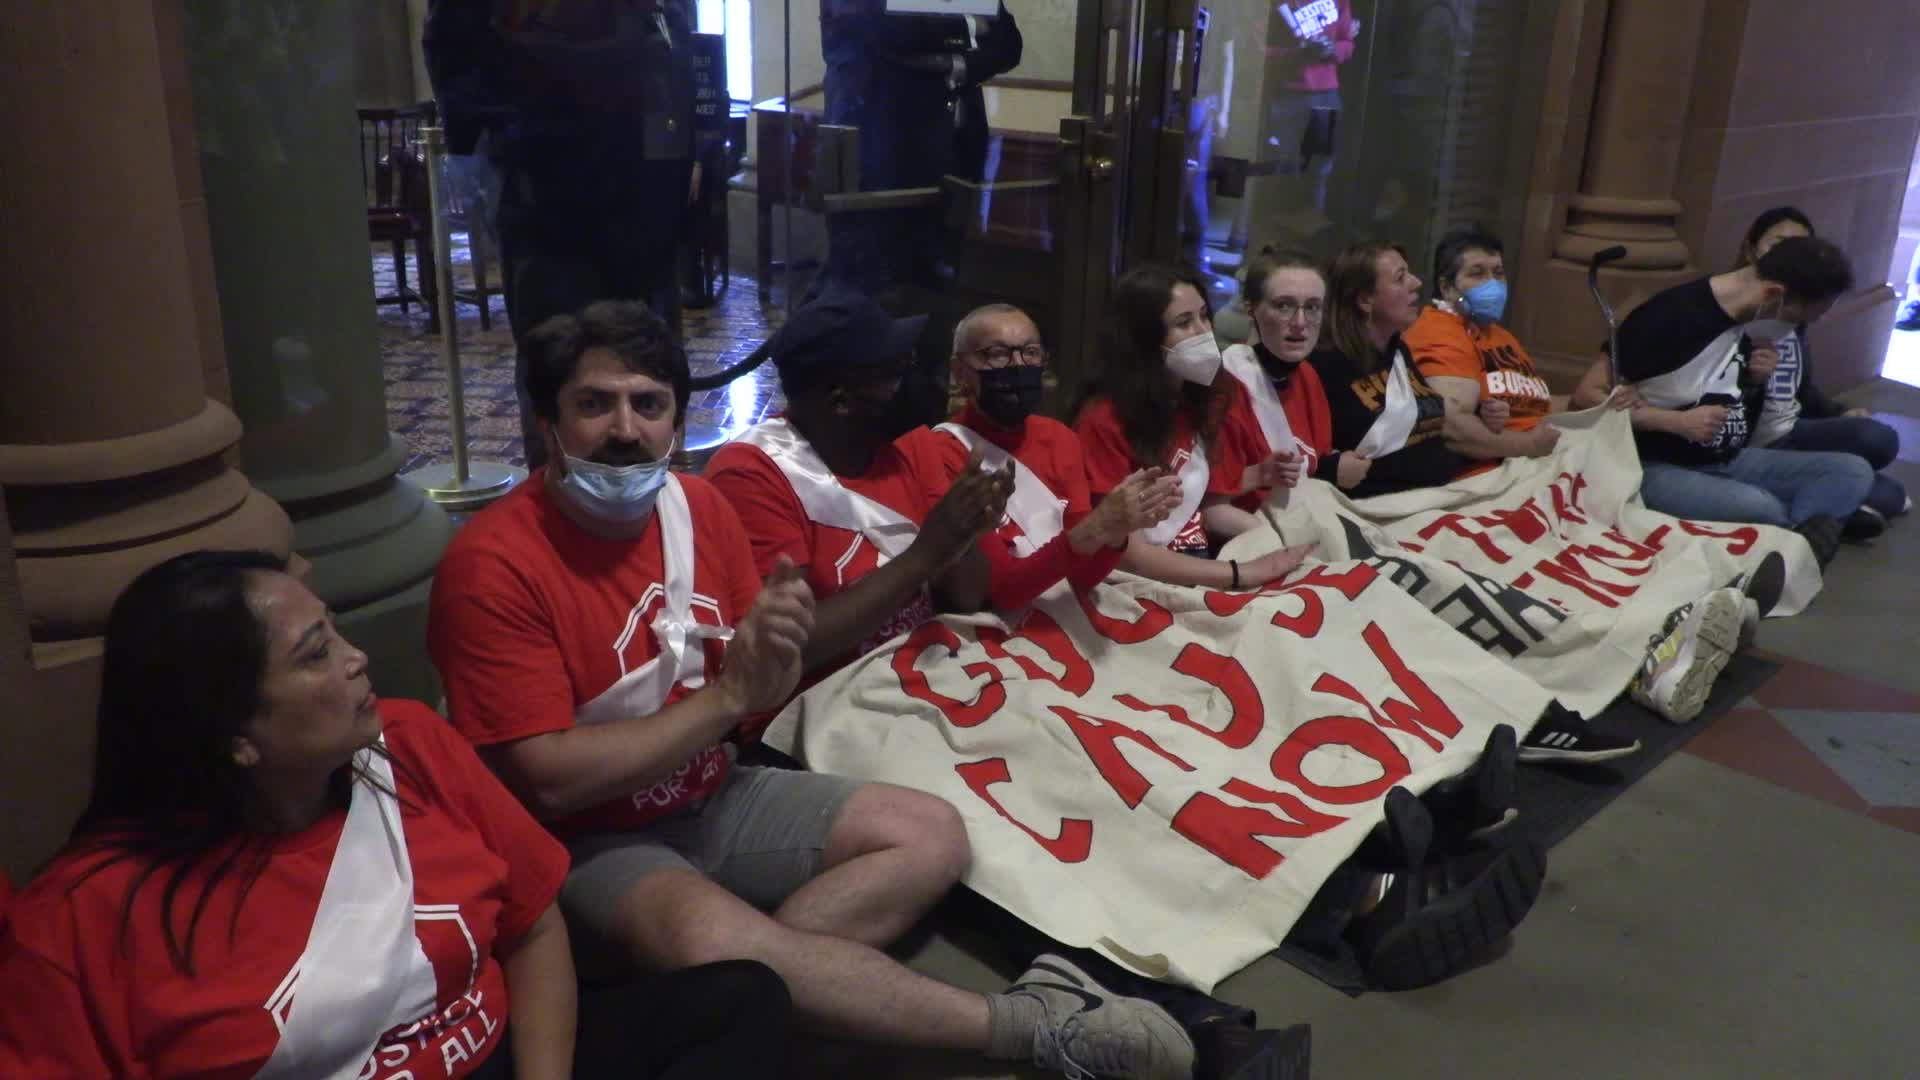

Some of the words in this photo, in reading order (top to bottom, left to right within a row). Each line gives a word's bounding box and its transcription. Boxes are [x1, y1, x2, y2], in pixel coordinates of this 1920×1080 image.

[1170, 620, 1464, 880] NOW
[632, 777, 688, 811] FOR
[439, 1008, 498, 1077] ALL
